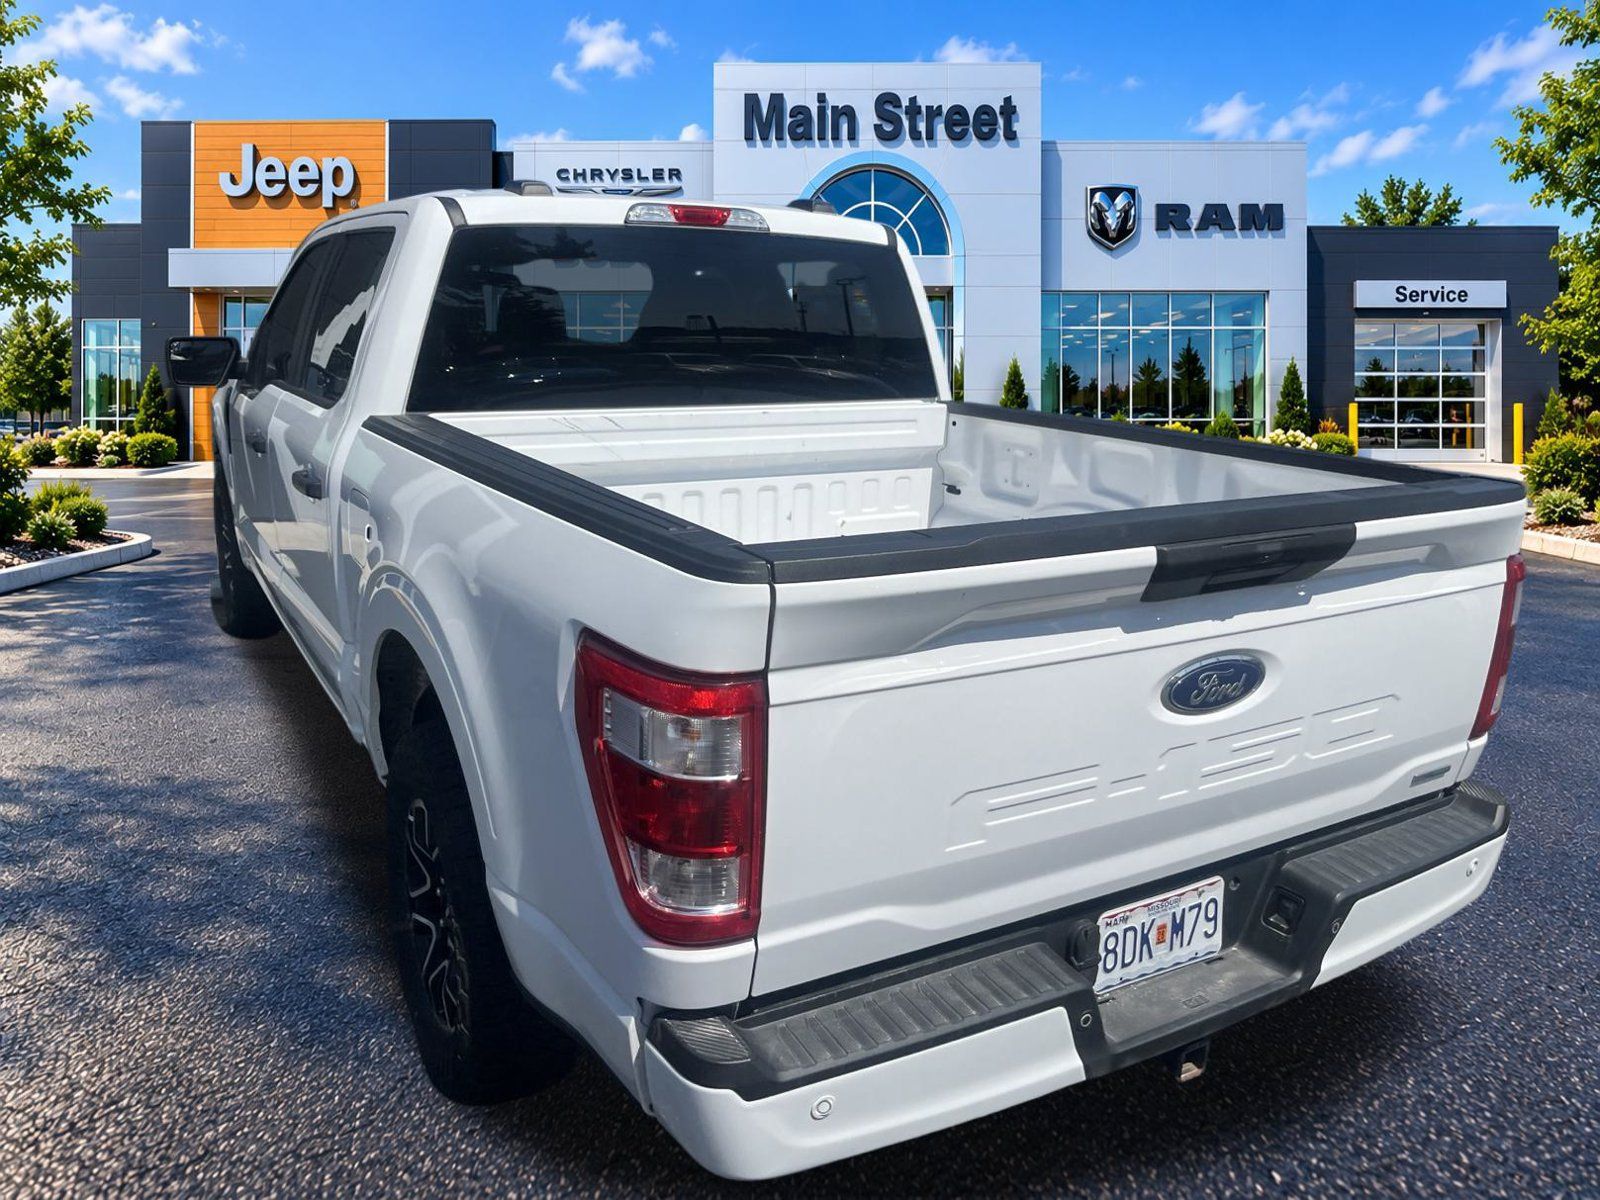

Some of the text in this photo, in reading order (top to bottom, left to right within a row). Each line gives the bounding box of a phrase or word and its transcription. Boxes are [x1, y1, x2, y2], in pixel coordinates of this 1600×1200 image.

[744, 91, 1017, 142] Main Street
[218, 143, 355, 209] Jeep
[556, 168, 683, 182] CHRYSLER
[1155, 203, 1284, 231] RAM
[1395, 285, 1468, 303] Service
[1190, 668, 1247, 706] Ford
[1147, 896, 1182, 912] MISSOURI
[1103, 897, 1218, 973] 8DK M79
